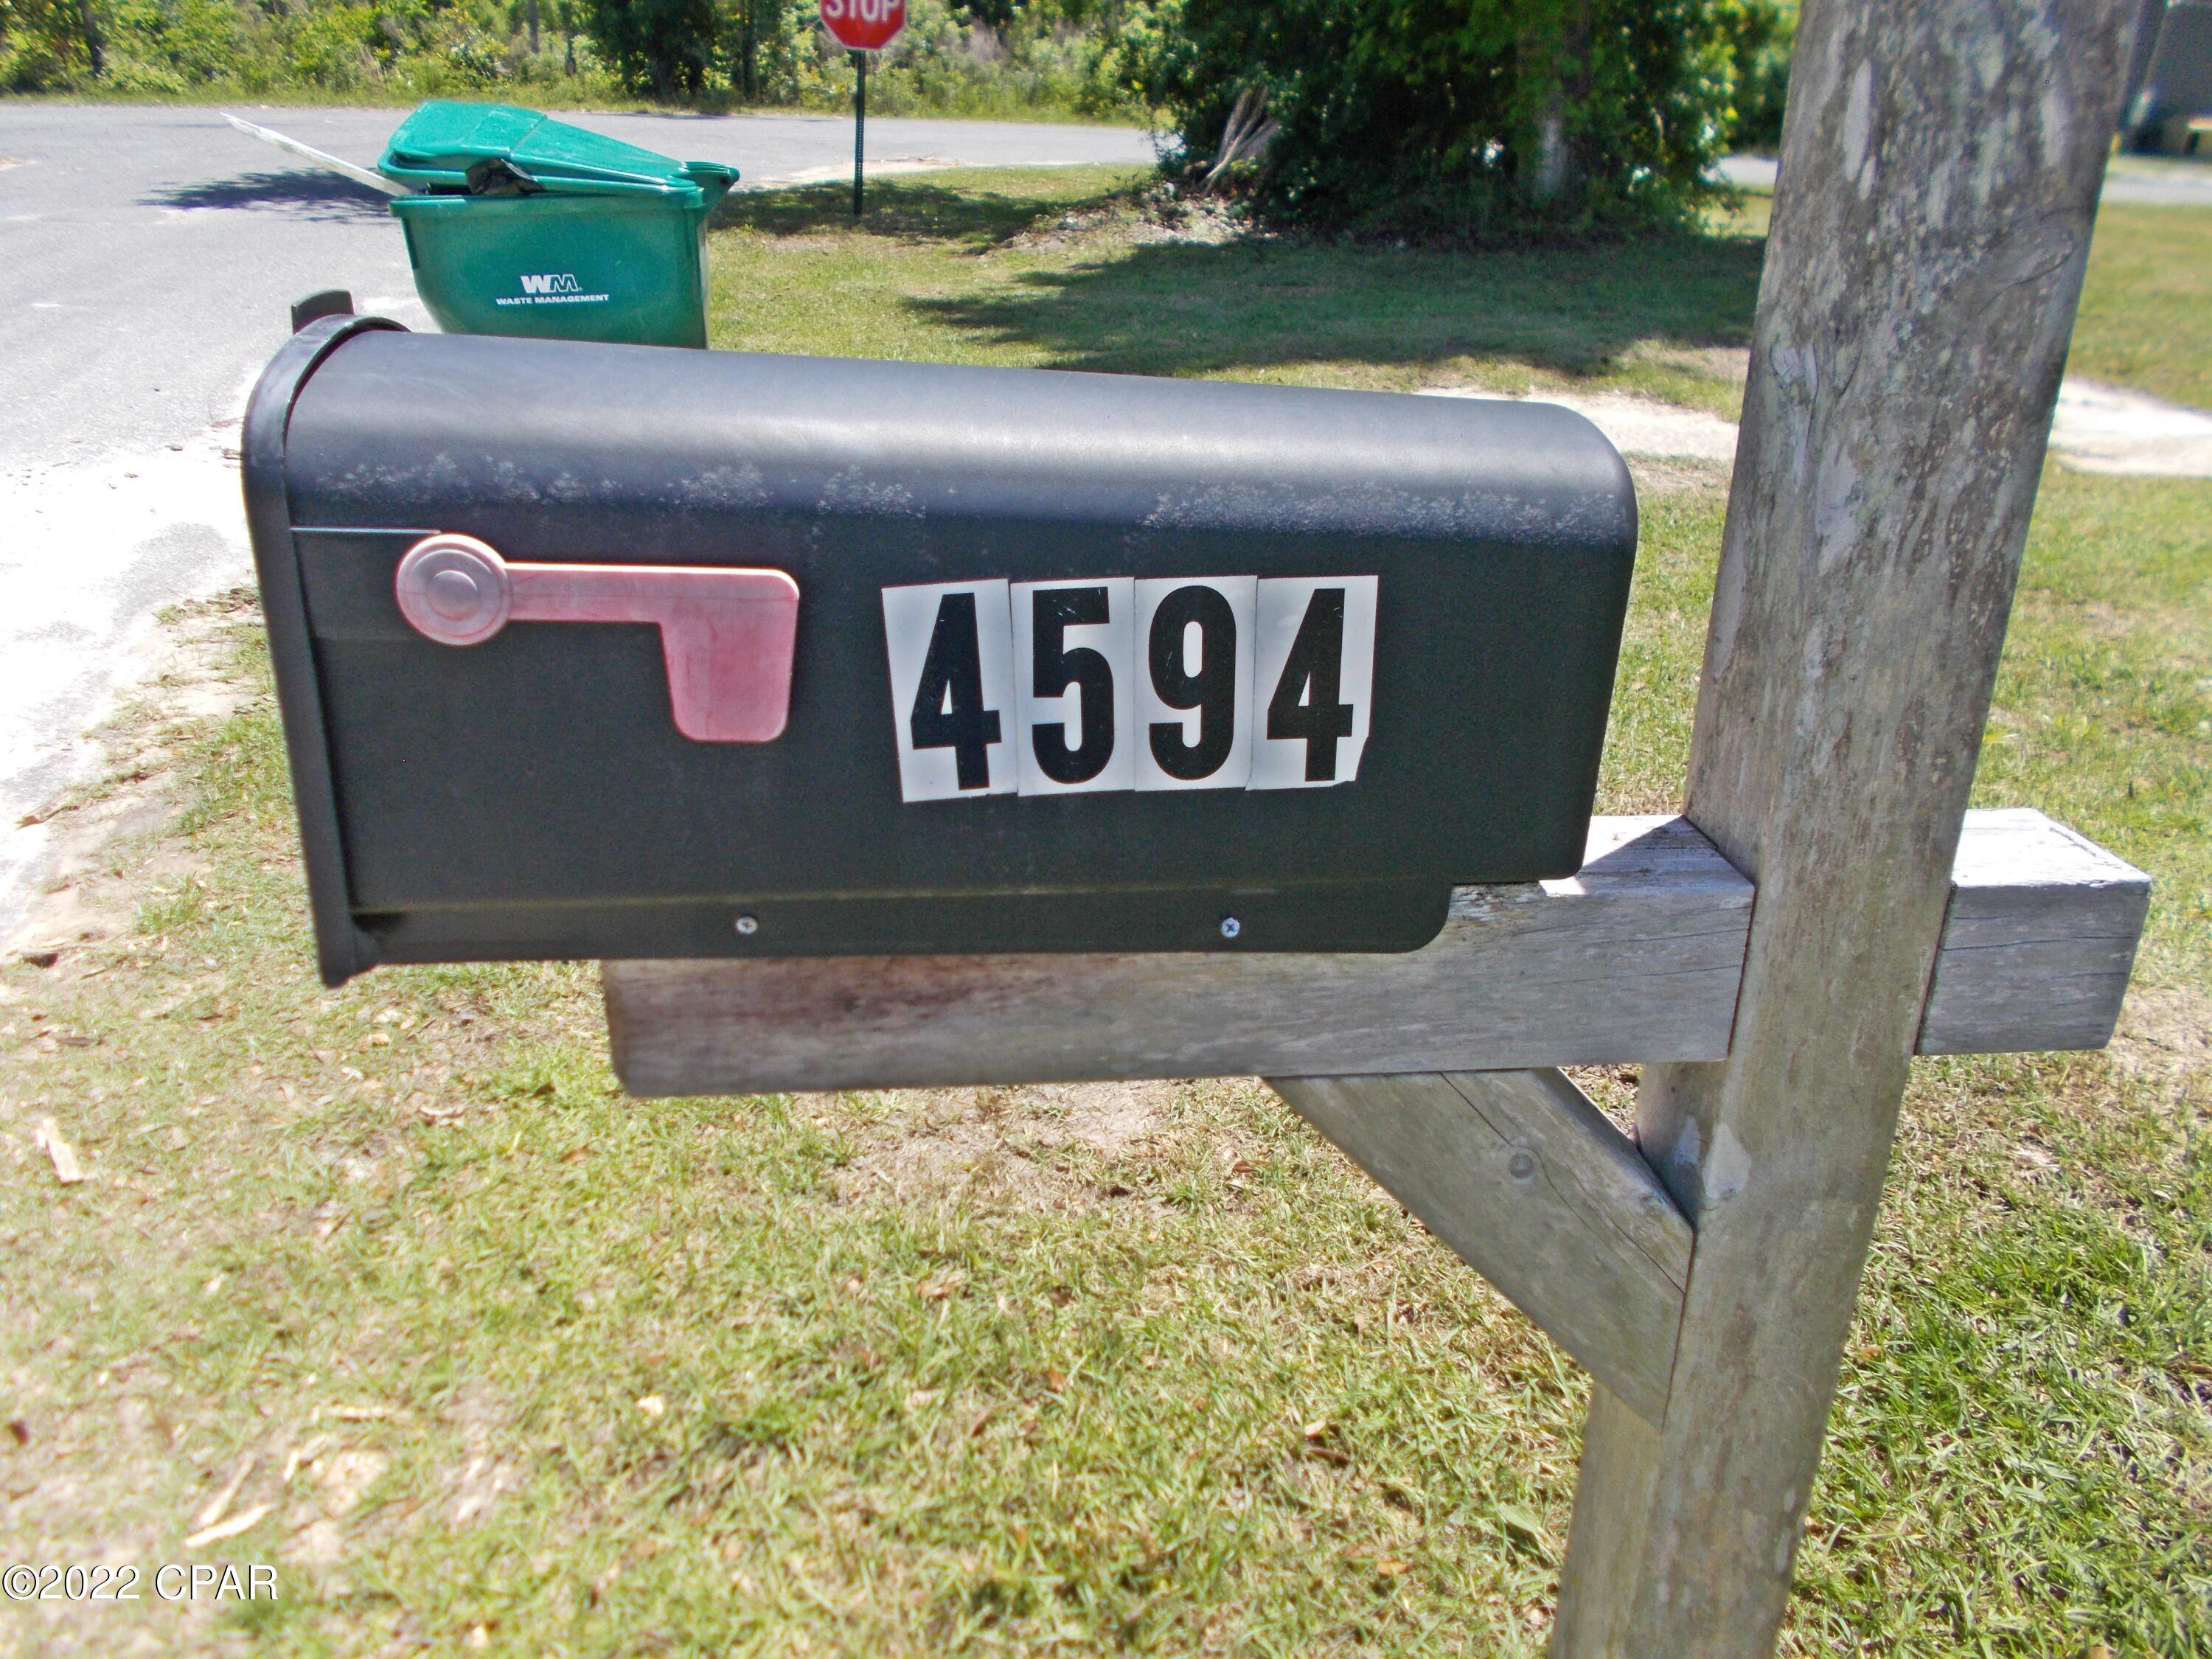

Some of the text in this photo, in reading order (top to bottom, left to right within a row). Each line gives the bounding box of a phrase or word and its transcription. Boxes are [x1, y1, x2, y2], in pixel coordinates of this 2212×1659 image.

[521, 274, 579, 293] WM
[496, 294, 609, 305] WASTE MANAGEMENT
[910, 585, 1354, 790] 4594
